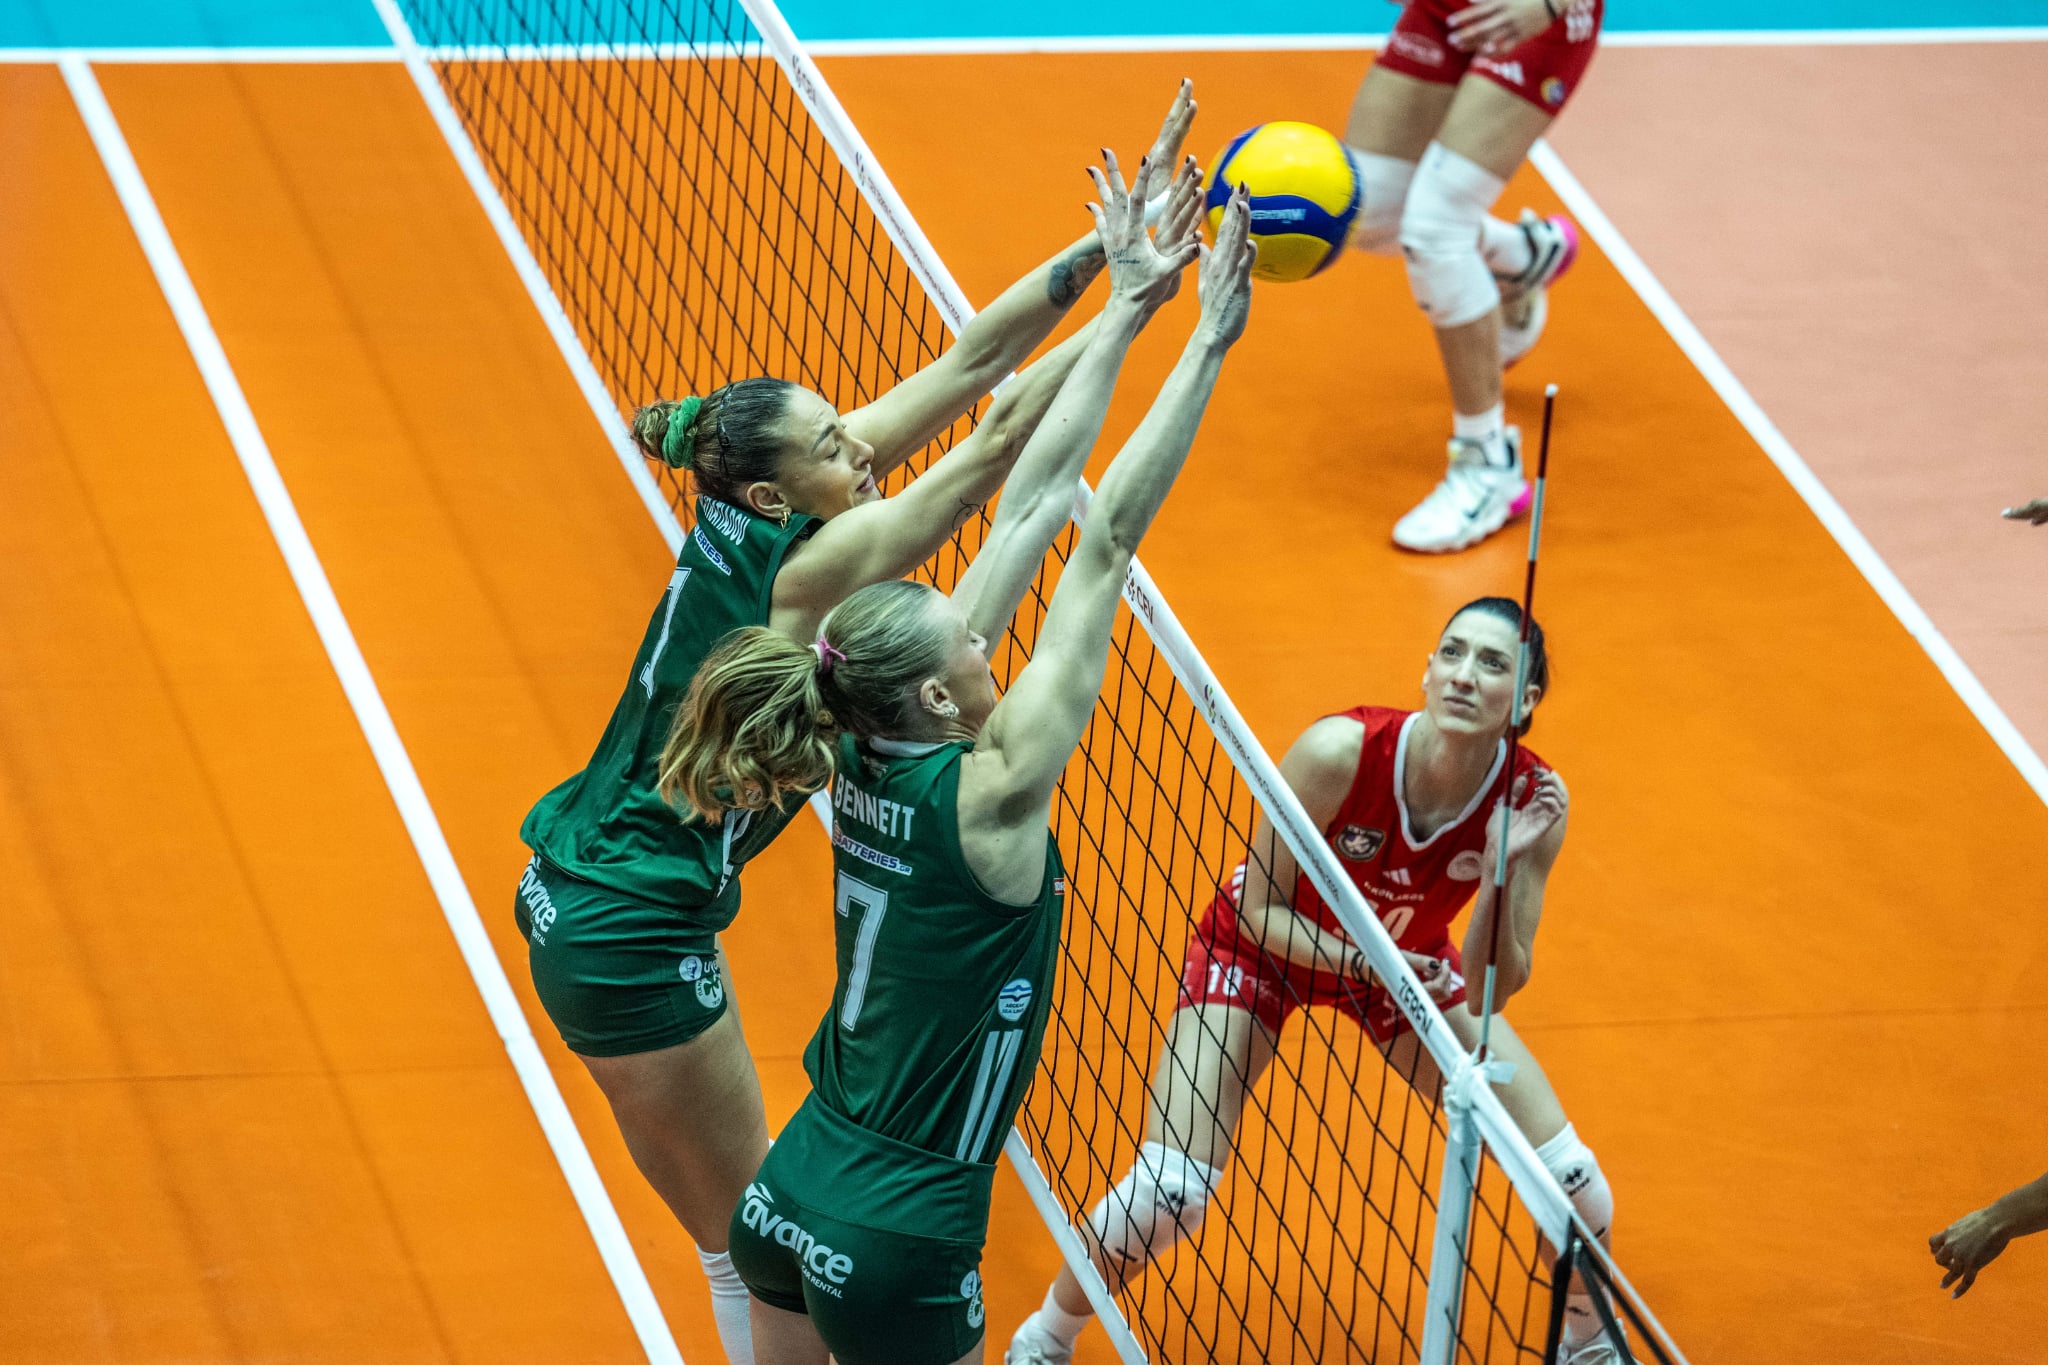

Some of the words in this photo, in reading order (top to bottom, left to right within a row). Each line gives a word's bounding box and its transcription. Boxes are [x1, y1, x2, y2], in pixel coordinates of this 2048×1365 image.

[833, 772, 915, 841] BENNETT
[836, 870, 888, 1032] 7
[1207, 961, 1244, 998] 10
[1399, 976, 1434, 1035] ZEREN
[742, 1197, 854, 1284] avance
[810, 1275, 844, 1299] RENTAL
